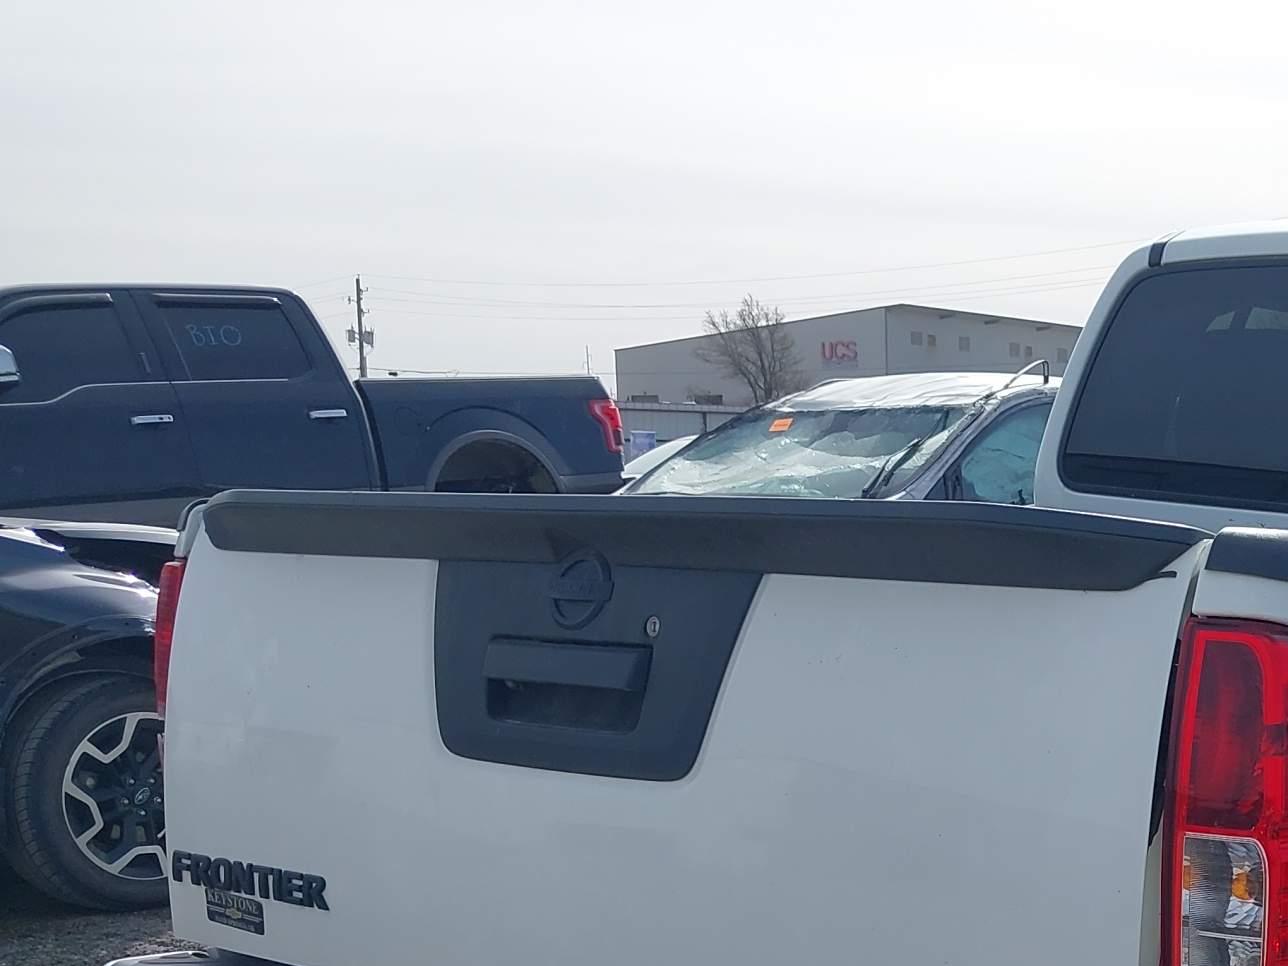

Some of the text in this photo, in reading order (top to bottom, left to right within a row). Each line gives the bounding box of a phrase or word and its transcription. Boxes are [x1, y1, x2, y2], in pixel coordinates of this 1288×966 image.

[821, 341, 858, 361] UCS
[172, 849, 330, 911] FRONTIER
[207, 888, 259, 915] KEYSTONE
